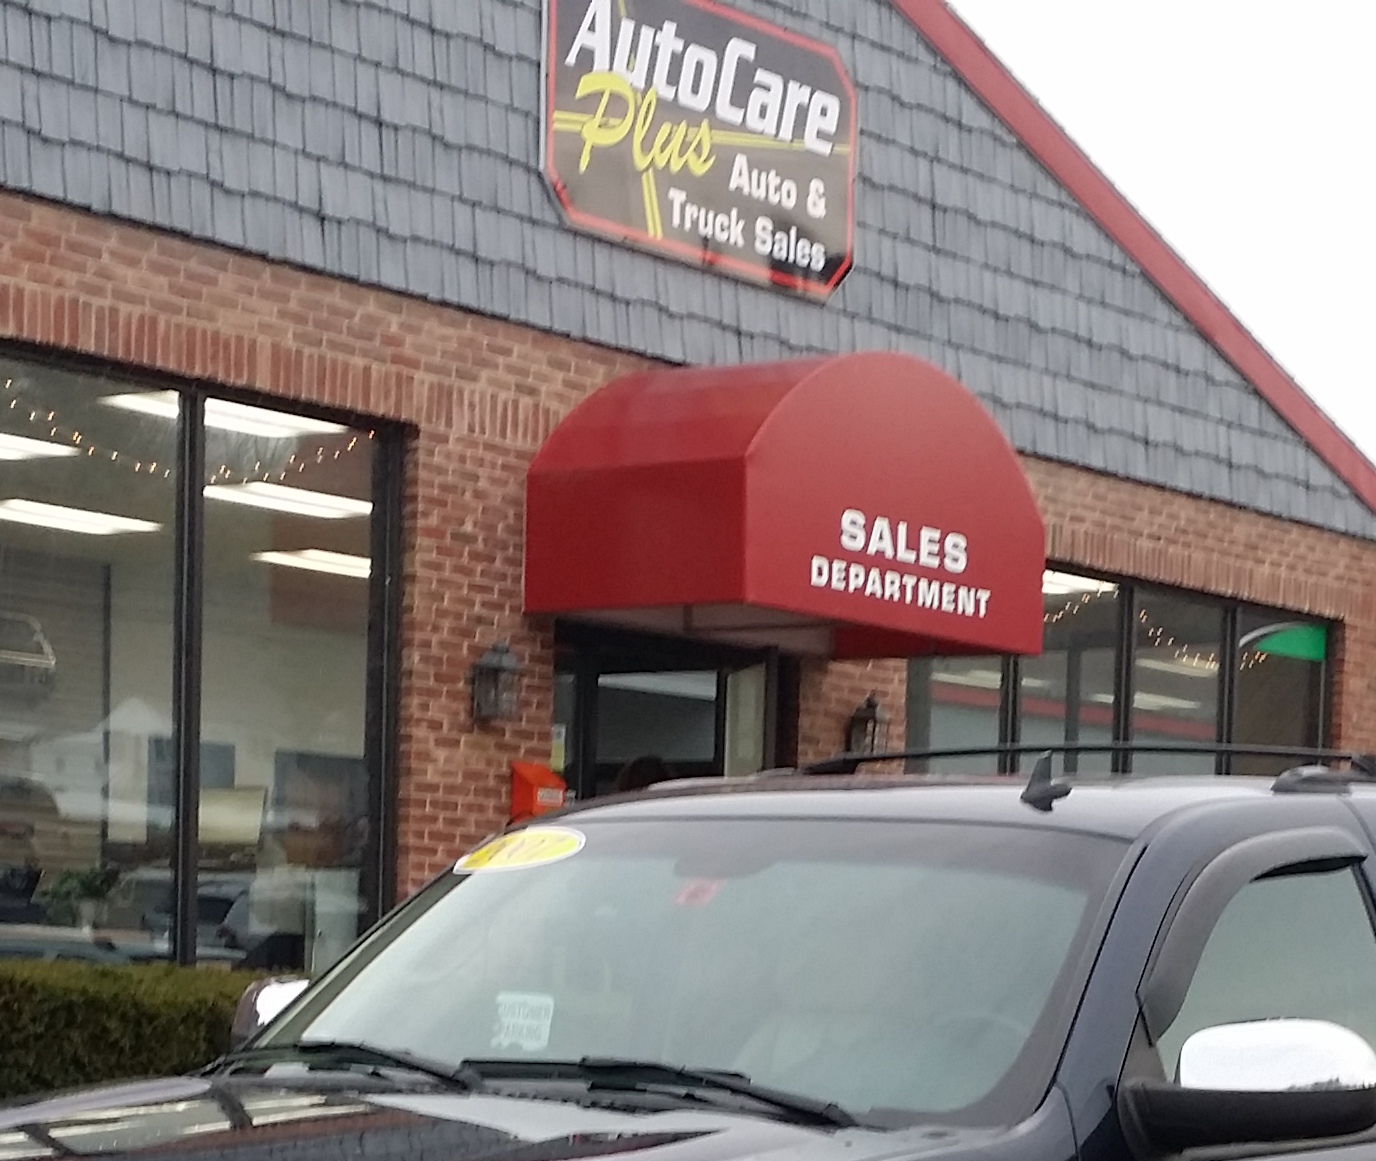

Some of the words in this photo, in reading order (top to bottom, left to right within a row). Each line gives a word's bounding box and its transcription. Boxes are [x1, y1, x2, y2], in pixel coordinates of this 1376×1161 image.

[565, 0, 841, 157] AutoCare
[575, 72, 717, 178] Plus
[729, 152, 798, 211] Auto
[806, 178, 827, 220] &
[668, 187, 746, 249] Truck
[754, 215, 827, 273] Sales
[840, 507, 969, 575] SALES
[810, 554, 993, 619] DEPARTMENT
